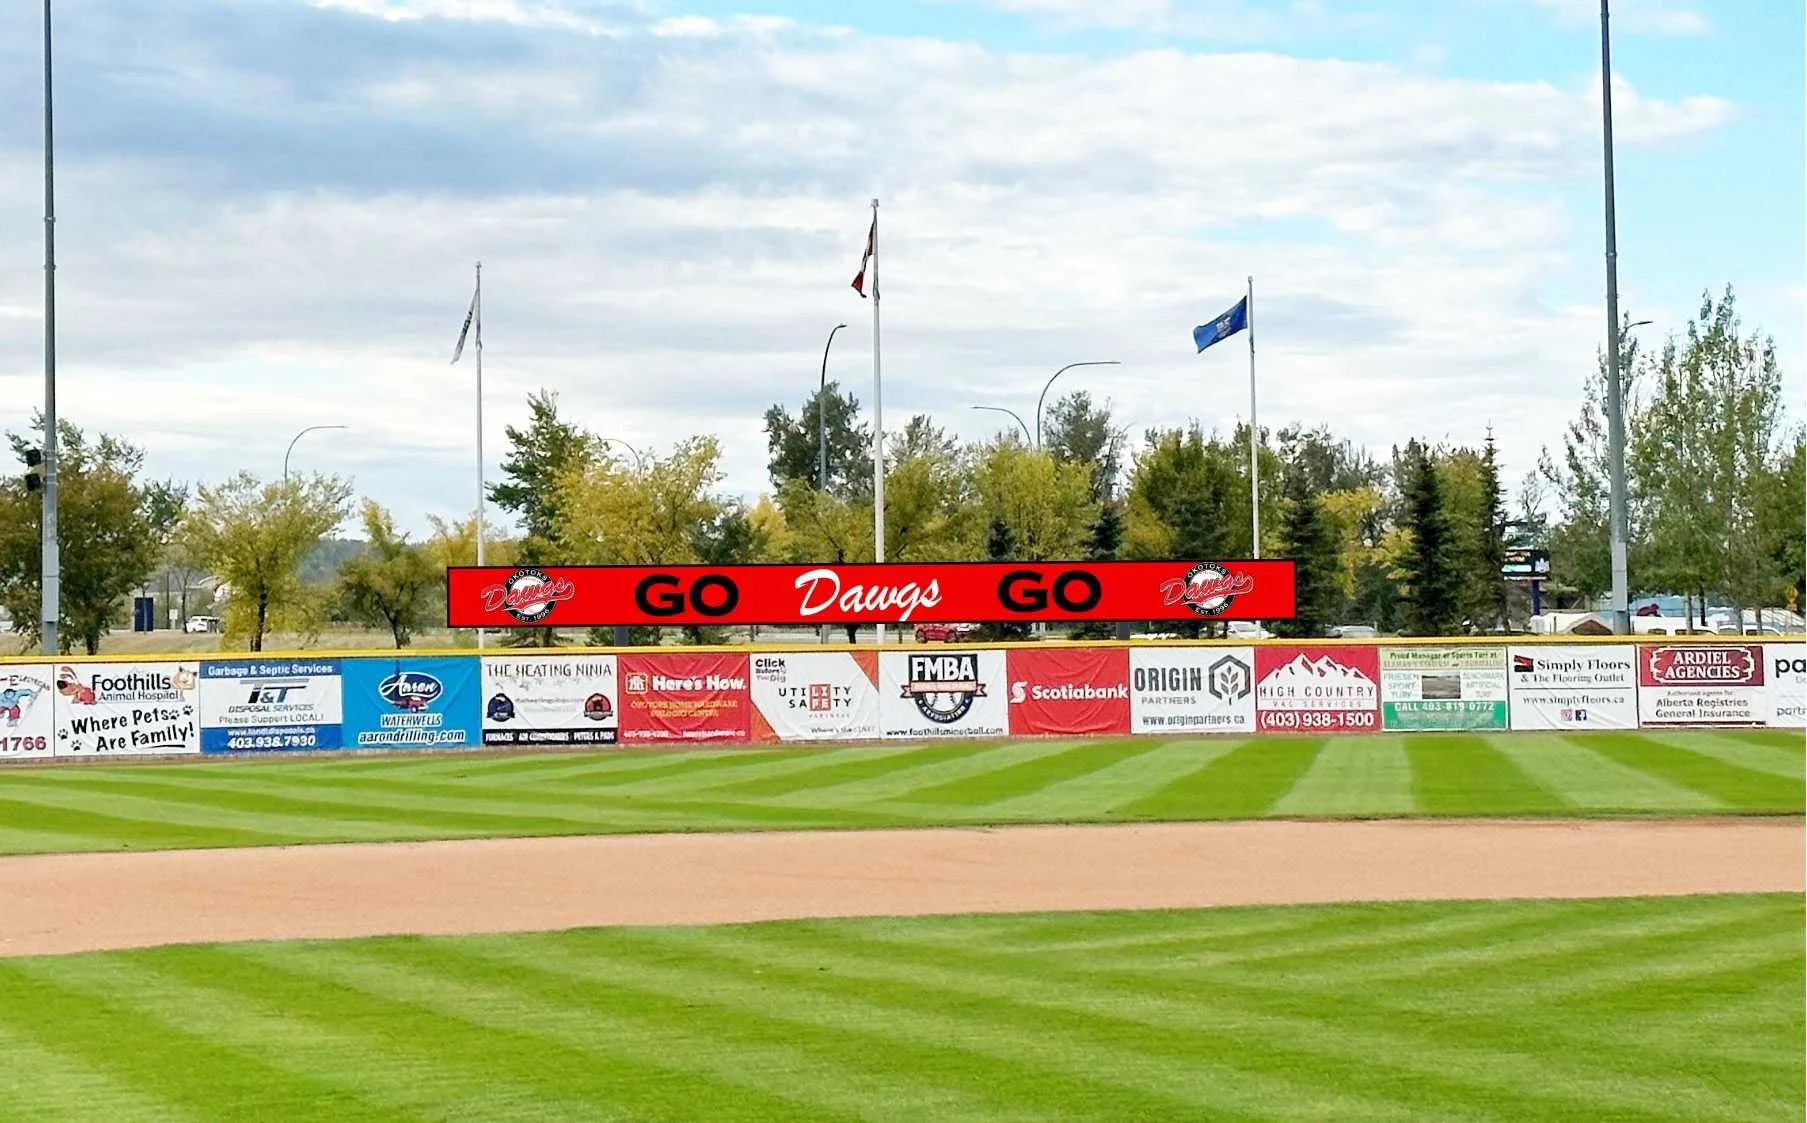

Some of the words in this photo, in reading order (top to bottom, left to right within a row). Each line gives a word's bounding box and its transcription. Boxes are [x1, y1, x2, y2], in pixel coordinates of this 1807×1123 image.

[508, 569, 548, 585] OKOTOKS
[1187, 563, 1227, 578] OKOTOKS
[481, 577, 575, 612] Dawgs
[634, 573, 739, 617] GO
[794, 568, 942, 622] Dawgs
[997, 570, 1103, 614] GO
[1160, 571, 1254, 605] Dawgs
[755, 658, 785, 668] Click
[1673, 651, 1731, 665] ARDIEL
[208, 666, 248, 677] Garbage
[250, 665, 257, 674] &
[259, 664, 290, 676] Septic
[291, 663, 333, 674] Services
[486, 664, 511, 677] THE
[515, 664, 572, 677] HEATING
[575, 664, 612, 677] NINJA
[911, 656, 975, 681] FMBA
[1537, 659, 1584, 672] Simply
[1588, 659, 1631, 669] Floors
[1665, 665, 1740, 679] AGENCIES
[92, 673, 171, 691] Foothills
[381, 674, 438, 695] Aaron
[652, 675, 703, 691] Here's
[705, 675, 746, 691] How.
[770, 674, 786, 683] Dig
[1134, 667, 1202, 692] ORIGIN
[1520, 674, 1528, 682] &
[1533, 673, 1550, 682] The
[1553, 673, 1592, 683] Flooring
[1594, 673, 1625, 682] Outlet
[98, 692, 135, 701] Animal
[137, 690, 179, 702] Hospital
[778, 686, 851, 697] UTILITY
[1031, 683, 1129, 701] Scotiabank
[1259, 686, 1296, 698] HIGH
[1304, 685, 1374, 697] COUNTRY
[789, 698, 852, 709] SAFETY
[1141, 696, 1196, 705] PARTNERS
[1272, 699, 1295, 708] VAC
[1303, 699, 1362, 708] SERVICES
[1394, 702, 1418, 711] CALL
[1522, 695, 1625, 706] www.simplyfloors.ca
[1656, 698, 1693, 707] Alberta
[1697, 698, 1749, 708] Registries
[228, 704, 270, 713] DISPOSAL
[273, 703, 314, 712] SERVICES
[1655, 709, 1695, 718] General
[1699, 708, 1750, 718] Insurance
[71, 714, 128, 735] Where
[132, 709, 169, 725] Pets
[219, 715, 248, 724] Please
[251, 714, 288, 724] Support
[290, 713, 324, 722] LOCAL!
[380, 713, 442, 727] WATERWELLS
[1142, 714, 1245, 727] www.originpartners.ca
[1260, 710, 1301, 728] (403)
[1302, 711, 1374, 727] 938-1500
[96, 735, 126, 752] Are
[131, 721, 195, 746] Family!
[227, 735, 316, 749] 403.938.7930
[358, 729, 465, 745] aarondrilling.com
